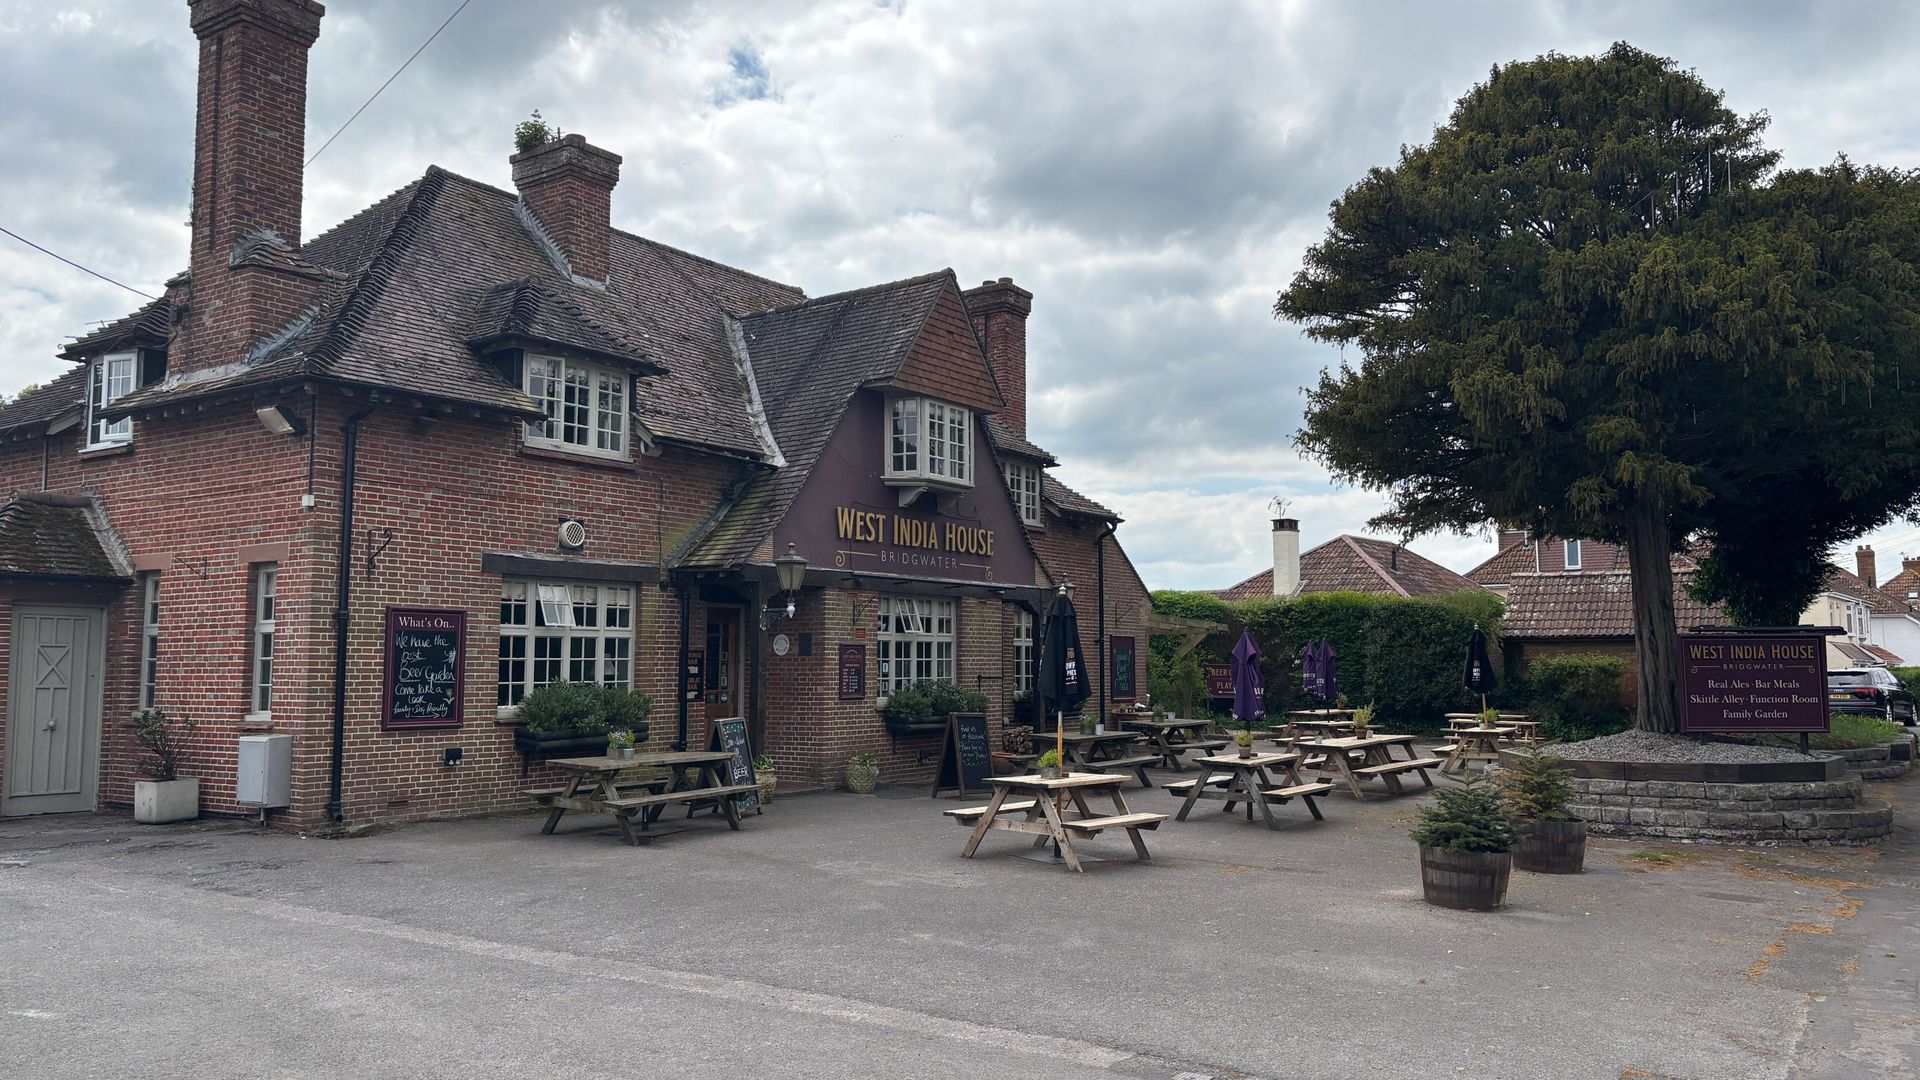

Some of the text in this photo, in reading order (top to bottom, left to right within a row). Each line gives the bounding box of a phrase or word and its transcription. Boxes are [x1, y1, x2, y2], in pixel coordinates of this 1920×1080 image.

[836, 506, 994, 556] WEST INDIA HOUSE
[881, 550, 958, 569] BRIDGWATER
[399, 616, 432, 628] What's
[395, 631, 450, 648] We have the
[402, 648, 424, 661] best
[1689, 645, 1815, 659] WEST INDIA HOUSE
[399, 660, 456, 687] Beer Garden
[1211, 668, 1227, 676] BEER
[395, 683, 416, 696] Come
[1708, 680, 1800, 689] Real Ales Bar Meals
[1690, 694, 1720, 704] Skittle
[1721, 694, 1745, 705] Alley
[1750, 694, 1789, 704] Function
[1791, 694, 1819, 704] Room
[1723, 709, 1788, 720] Family Garden
[733, 766, 749, 780] BEER
